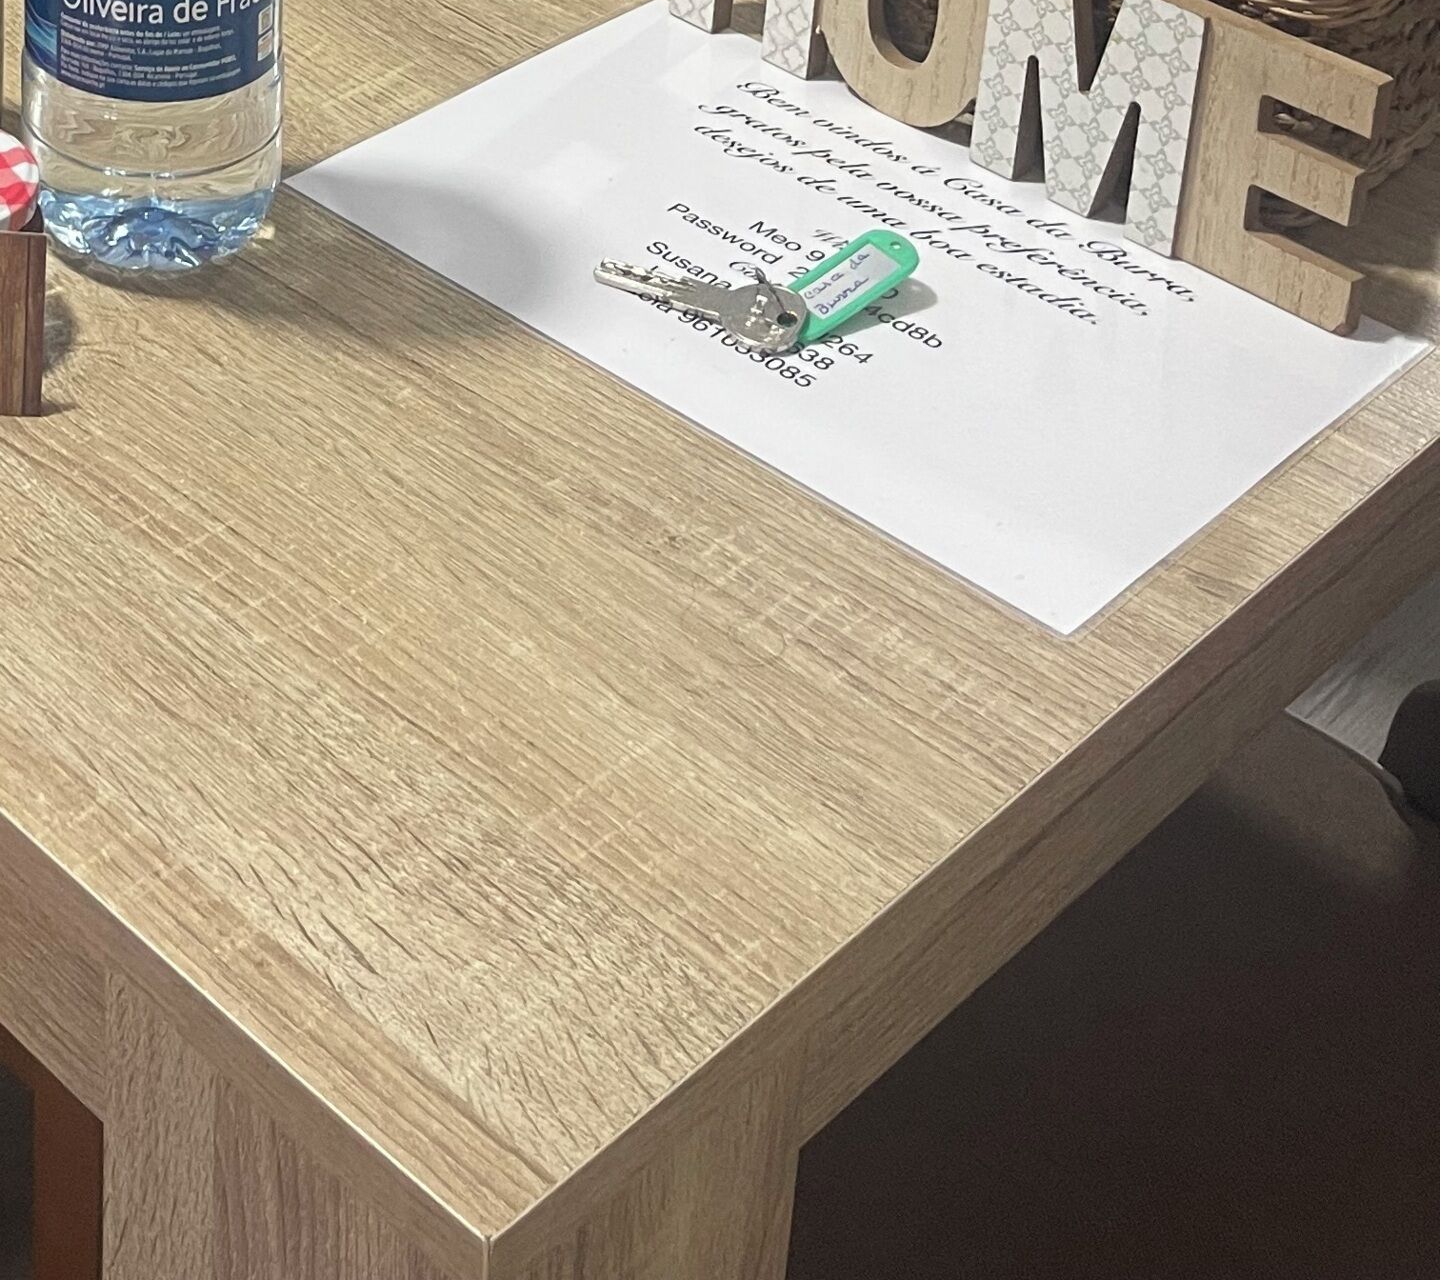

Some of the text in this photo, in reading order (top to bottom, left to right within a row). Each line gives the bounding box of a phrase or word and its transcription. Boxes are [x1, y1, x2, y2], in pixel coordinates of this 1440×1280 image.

[667, 203, 783, 264] Password
[694, 125, 1096, 325] desejos de uma boa estadia.
[698, 104, 1148, 316] gratos pela vossa preferência,
[736, 81, 810, 117] Bem
[813, 118, 909, 163] vindos
[944, 177, 1025, 217] Casa
[1027, 219, 1074, 240] da
[1079, 240, 1194, 302] Burra,
[749, 221, 801, 252] Meo
[647, 242, 732, 290] Susana
